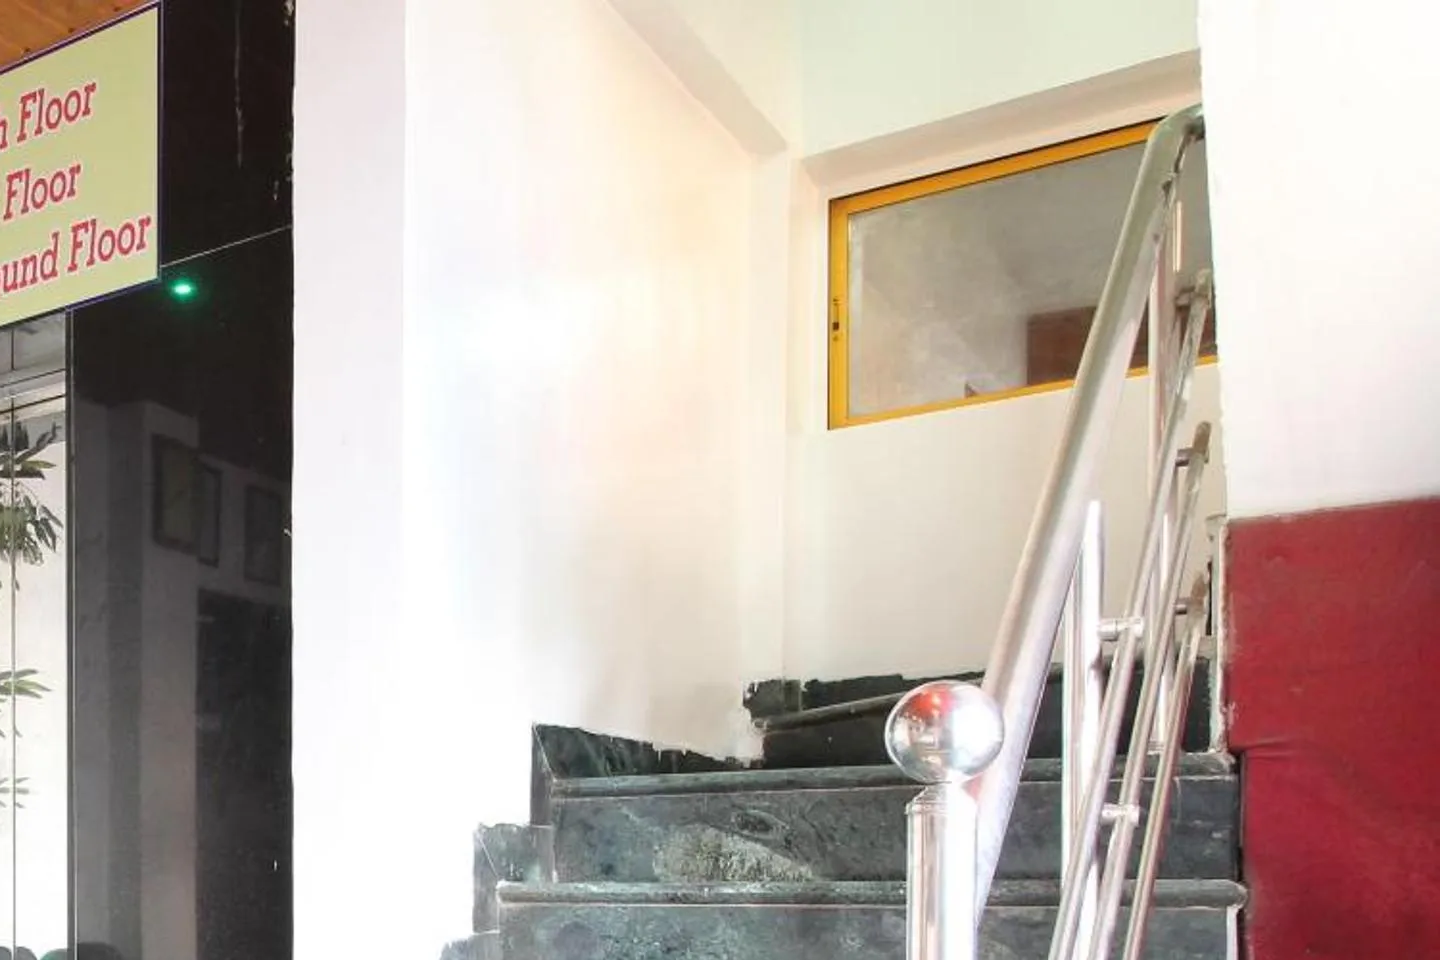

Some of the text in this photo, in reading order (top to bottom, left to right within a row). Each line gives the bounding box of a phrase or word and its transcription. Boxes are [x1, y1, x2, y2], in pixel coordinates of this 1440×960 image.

[16, 82, 97, 143] Floor
[3, 163, 82, 221] Floor
[67, 216, 152, 273] Floor
